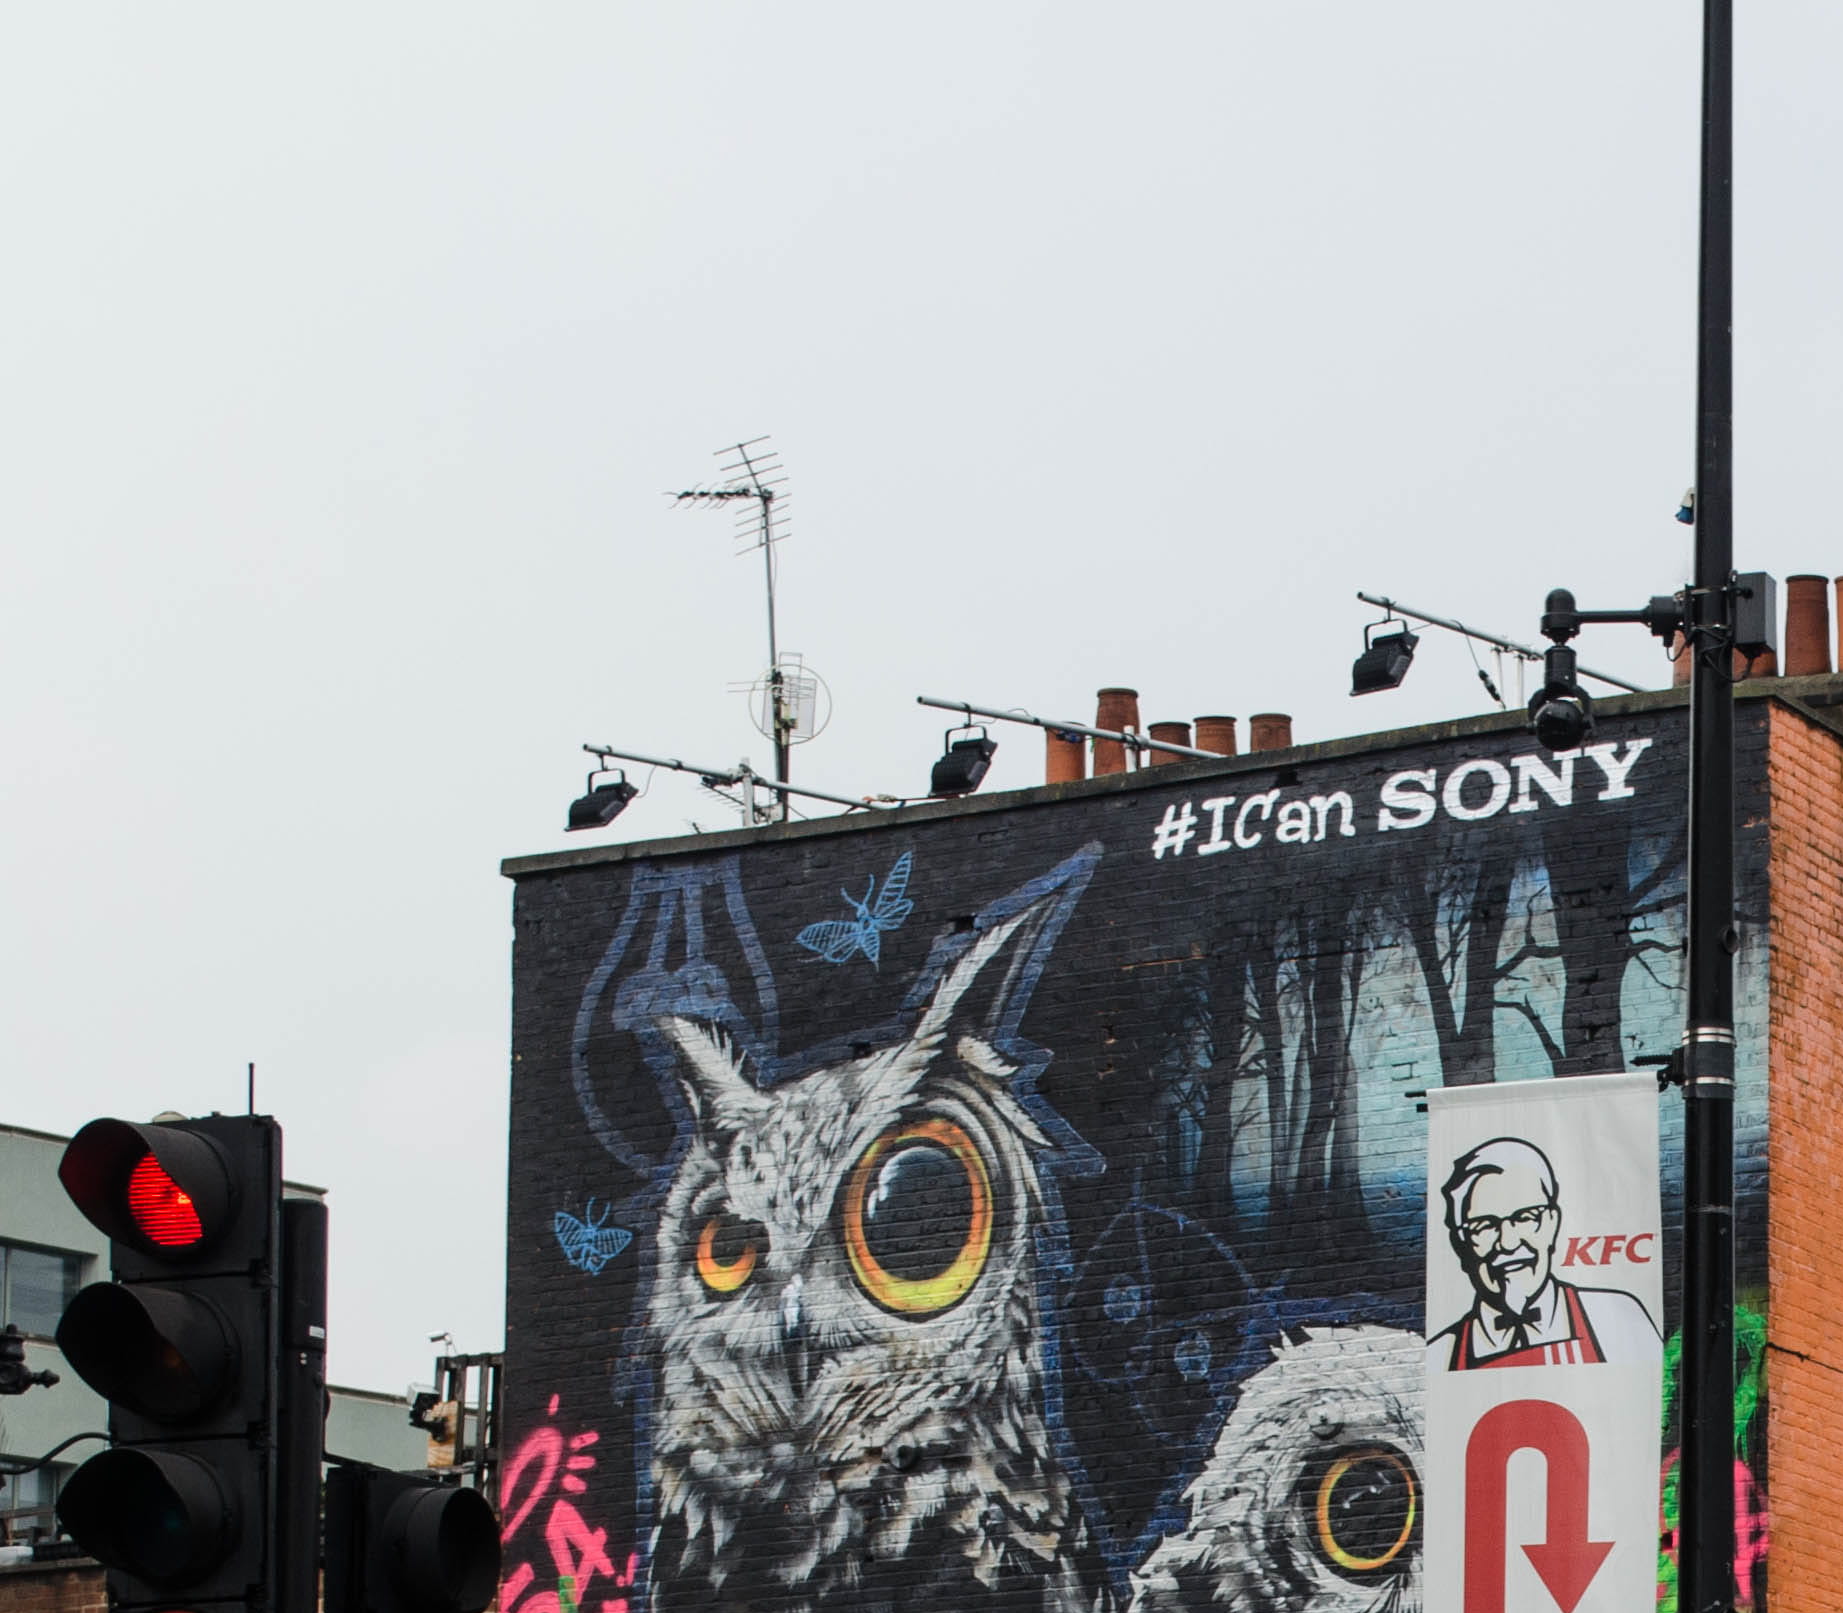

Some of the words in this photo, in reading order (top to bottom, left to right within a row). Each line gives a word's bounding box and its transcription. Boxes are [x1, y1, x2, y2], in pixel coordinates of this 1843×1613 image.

[1152, 789, 1356, 859] #ICan
[1378, 738, 1653, 833] SONY
[1560, 1233, 1654, 1268] KFC
